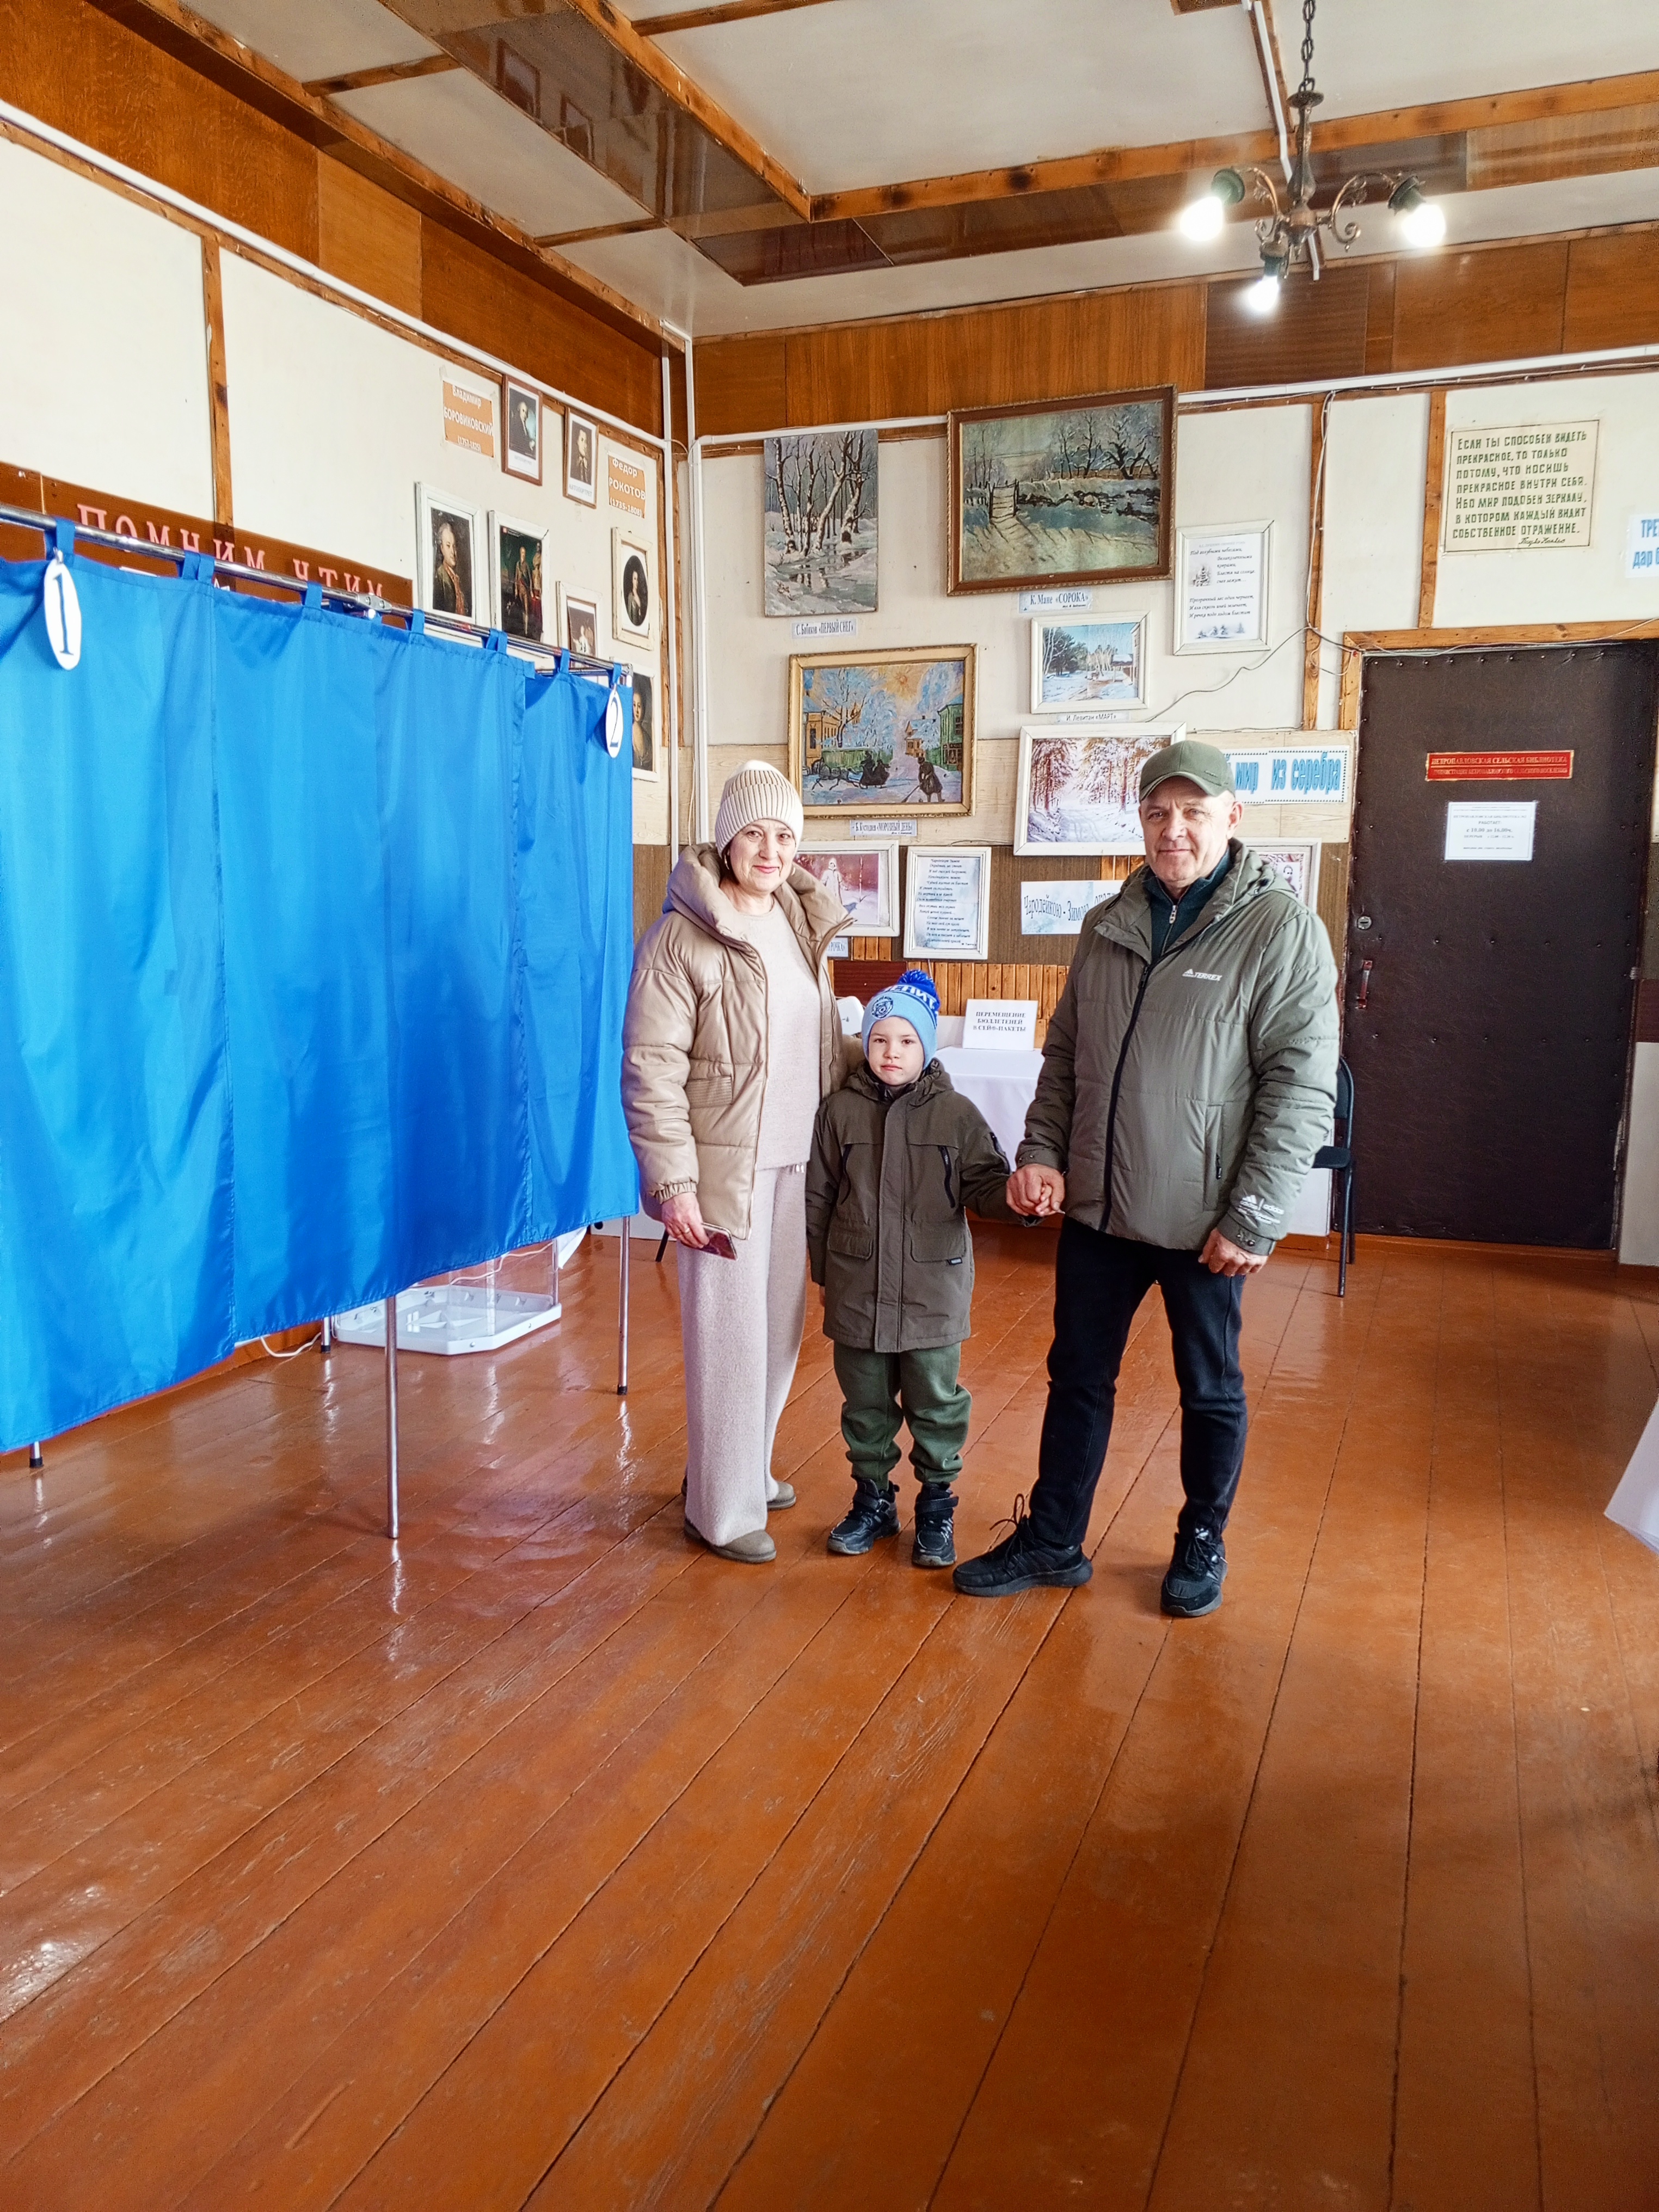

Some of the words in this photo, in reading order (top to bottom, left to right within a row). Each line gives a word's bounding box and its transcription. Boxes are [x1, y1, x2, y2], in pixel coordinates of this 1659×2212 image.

[452, 384, 481, 409] Владимир
[444, 406, 493, 436] БОРОВИКОВСКИЙ
[1486, 438, 1500, 447] ТЫ
[1504, 434, 1551, 446] СПОСОБЕН
[1555, 431, 1587, 443] ВИДЕТЬ
[1457, 452, 1514, 464] ПРЕКРАСНОЕ,
[1516, 451, 1527, 460] ТО
[1532, 447, 1568, 459] ТОЛЬКО
[612, 458, 637, 478] Федор
[1457, 468, 1500, 479] ПОТОМУ,
[1503, 465, 1521, 476] ЧТО
[1526, 463, 1569, 475] НОСИШЬ
[609, 477, 646, 500] РОКОТОВ
[1457, 481, 1515, 494] ПРЕКРАСНОЕ
[1520, 478, 1557, 489] ВНУТРИ
[1561, 476, 1587, 487] СЕБЯ.
[610, 497, 642, 517] (1735-1808)
[1456, 497, 1474, 509] ИБО
[1478, 497, 1498, 508] МИР
[1502, 495, 1543, 507] ПОДОБЕН
[1546, 493, 1587, 504] ЗЕРКАЛУ,
[1455, 515, 1461, 524] В
[1465, 512, 1509, 524] КОТОРОМ
[1514, 507, 1554, 521] КАЖДЫЙ
[1558, 507, 1587, 519] ВИДИТ
[1452, 526, 1516, 538] СОБСТВЕННОЕ
[1521, 523, 1580, 535] ОТРАЖЕНИЕ.
[1641, 519, 1659, 538] ТРЕ
[1632, 551, 1653, 569] дар
[1030, 594, 1036, 605] К.
[1037, 594, 1053, 604] Мане
[1056, 592, 1089, 604] «СОРОКА»
[53, 573, 74, 655] 1
[610, 696, 619, 747] 2
[1235, 762, 1259, 795] мир
[1270, 759, 1287, 790] из
[1291, 751, 1341, 795] серебра
[1024, 894, 1061, 919] Чародейкою
[1195, 972, 1222, 981] TERREX
